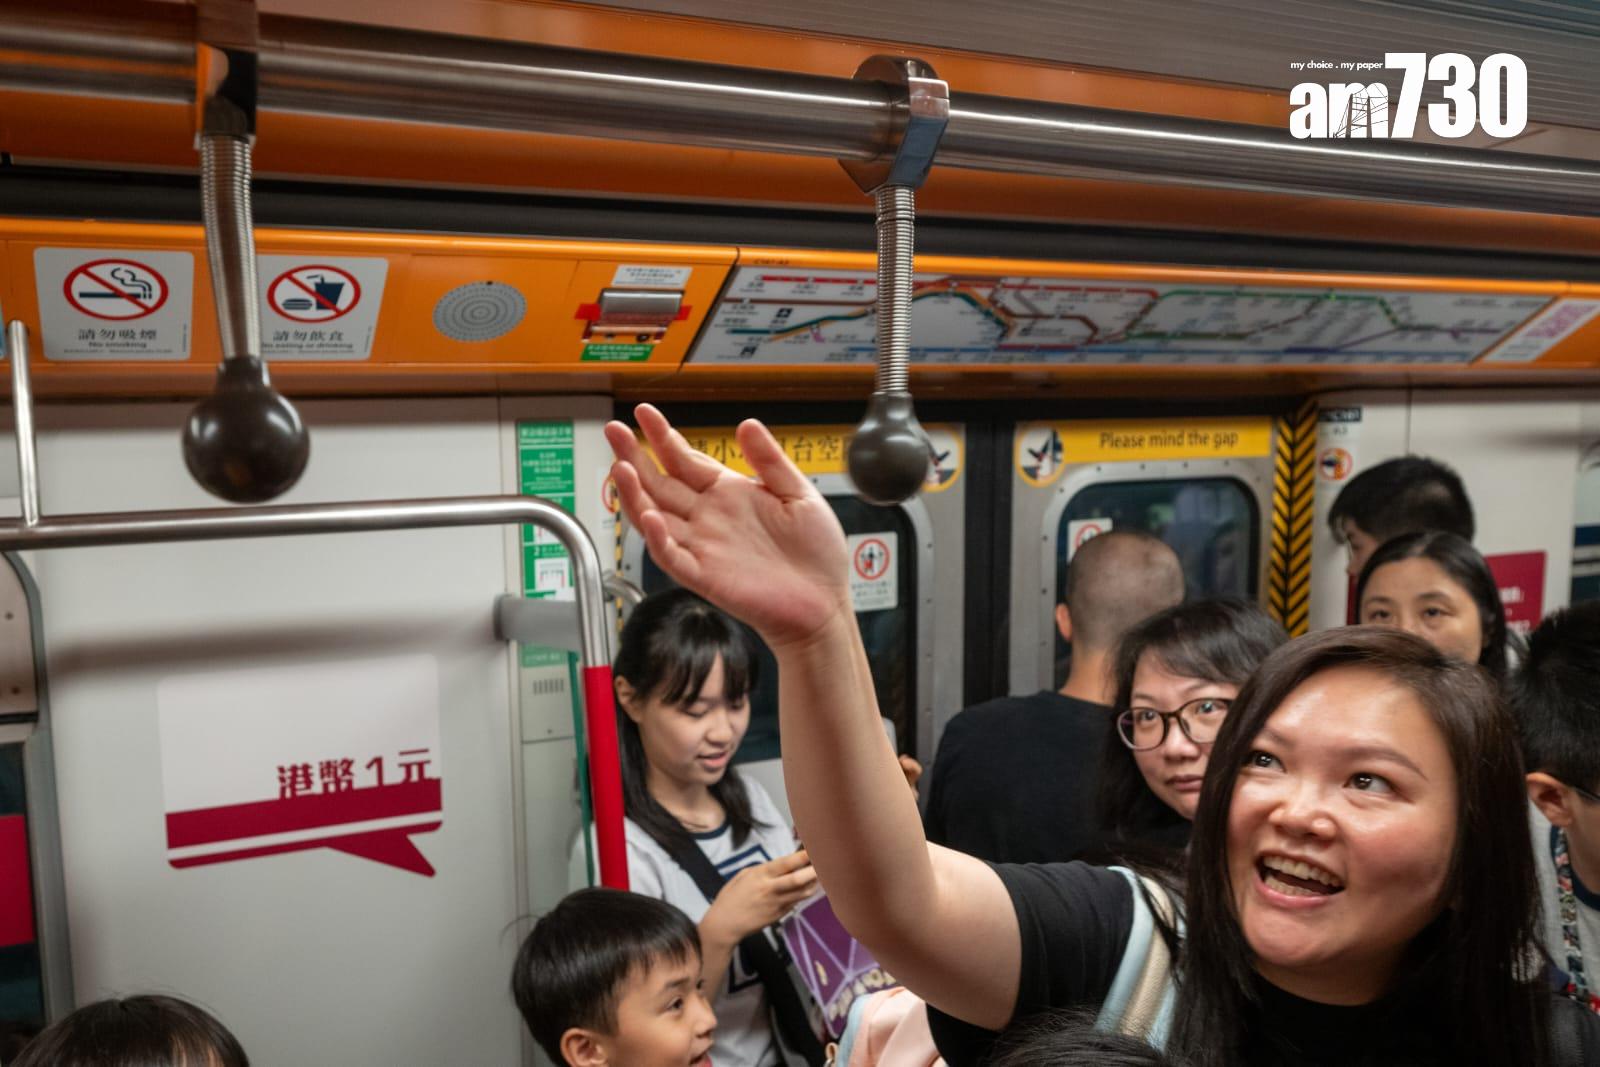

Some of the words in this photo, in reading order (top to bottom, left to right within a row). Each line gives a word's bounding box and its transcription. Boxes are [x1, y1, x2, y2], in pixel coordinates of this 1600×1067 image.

[105, 341, 147, 349] smoking
[1100, 431, 1145, 450] Please
[1148, 429, 1185, 448] mind
[1187, 428, 1210, 446] the
[1213, 431, 1239, 451] gap
